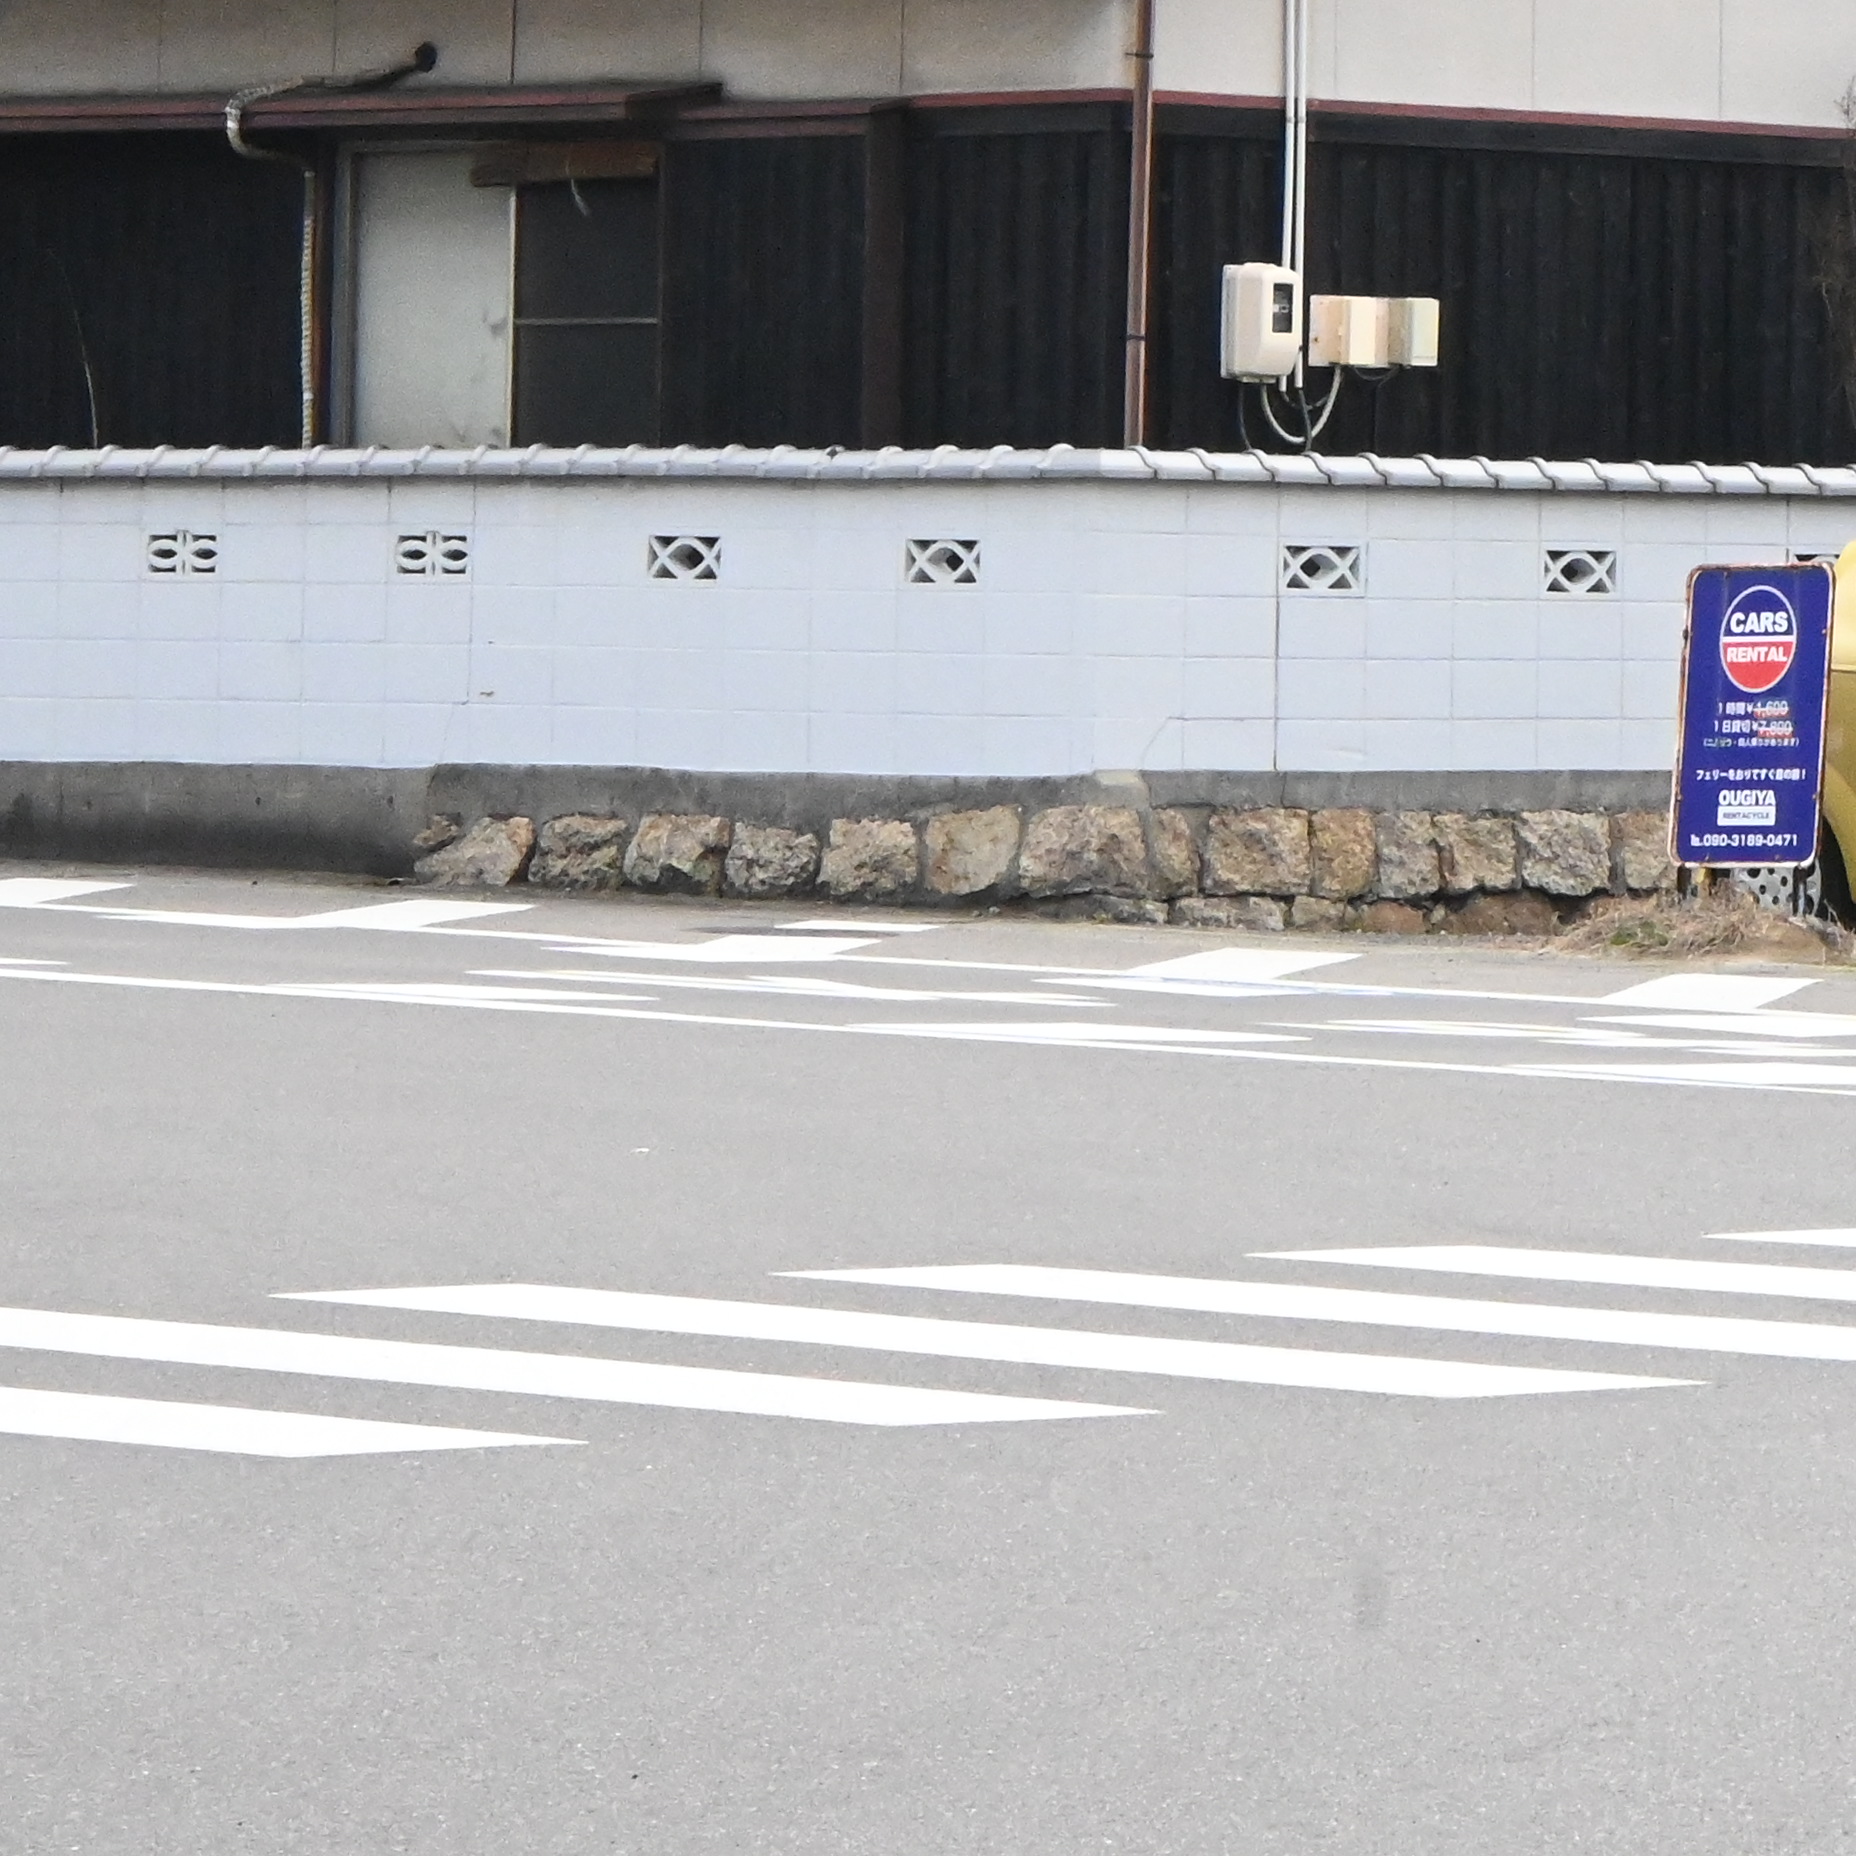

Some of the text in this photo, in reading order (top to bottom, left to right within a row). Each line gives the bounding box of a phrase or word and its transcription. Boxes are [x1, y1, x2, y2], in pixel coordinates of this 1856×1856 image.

[1729, 611, 1789, 634] CARS
[1726, 646, 1788, 662] RENTAL
[1718, 789, 1777, 806] OUGIYA
